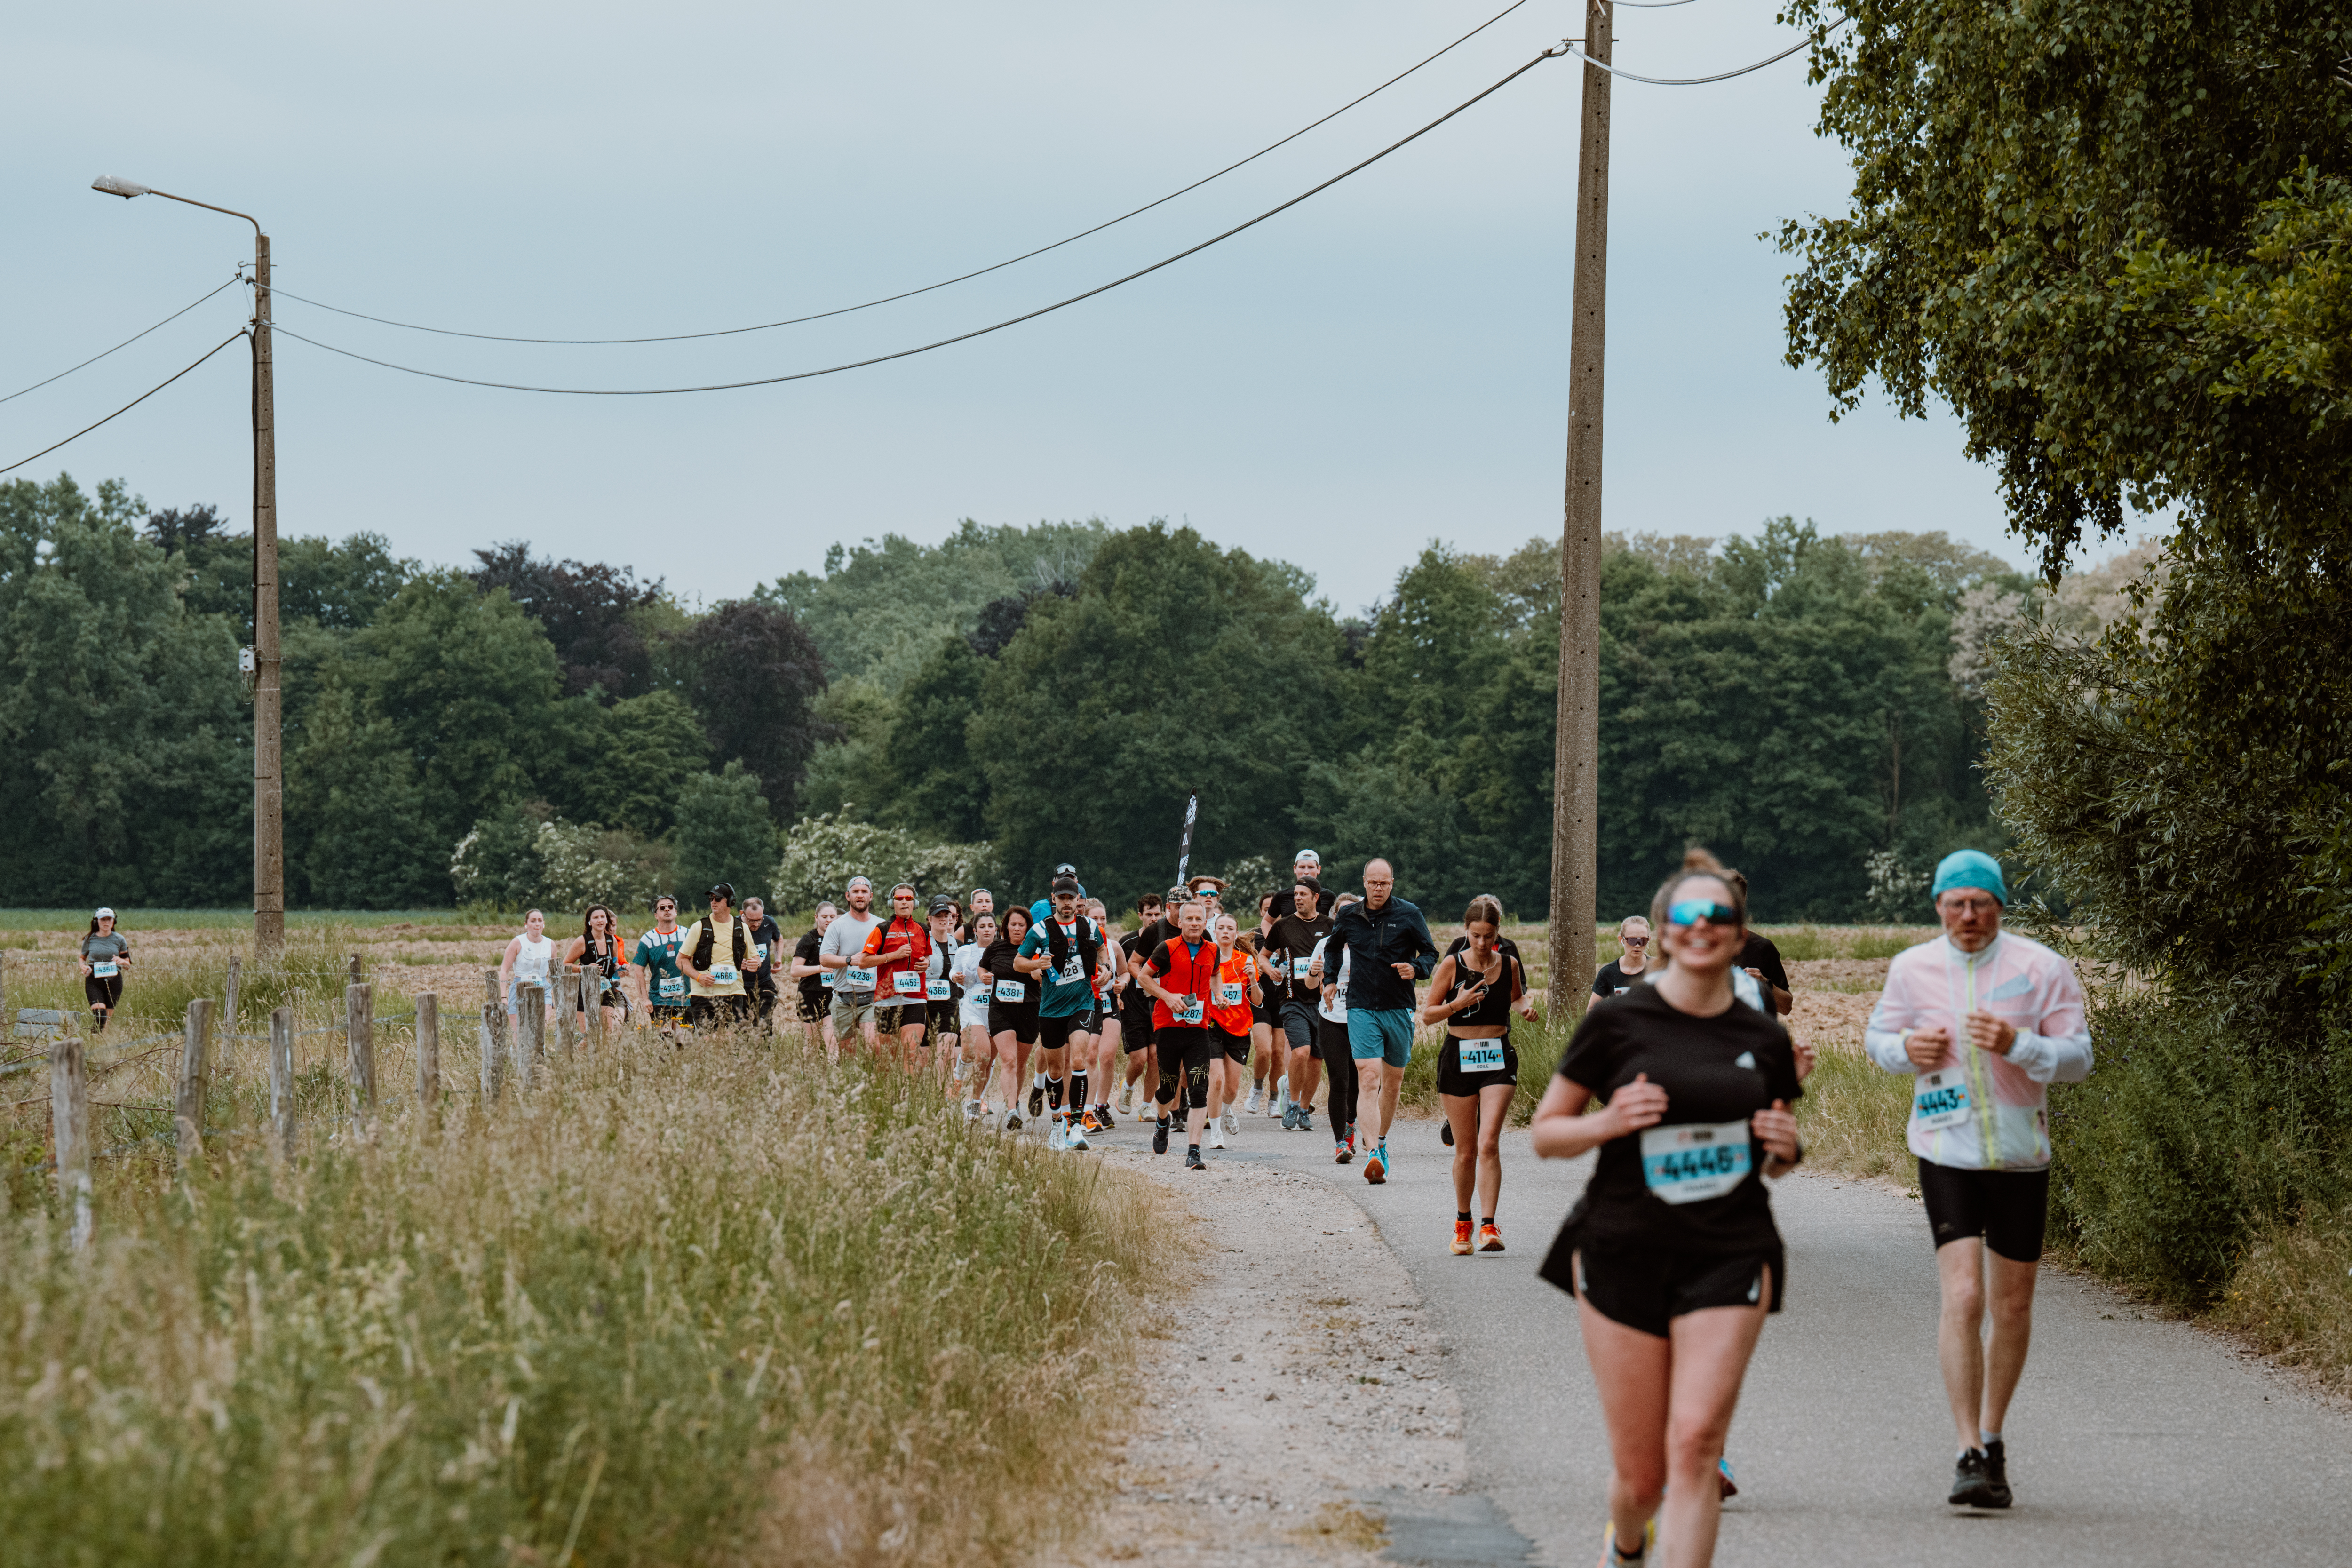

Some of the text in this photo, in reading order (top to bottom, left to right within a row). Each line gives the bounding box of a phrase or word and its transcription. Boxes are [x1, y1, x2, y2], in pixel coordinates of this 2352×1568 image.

[851, 971, 870, 981] 4238
[899, 979, 916, 987] 4456
[1000, 988, 1019, 997] 4381
[1223, 991, 1237, 999] 457
[1179, 1009, 1199, 1018] 4287
[1468, 1050, 1496, 1063] 4114
[1921, 1088, 1958, 1115] 4443
[1664, 1145, 1734, 1180] 4446
